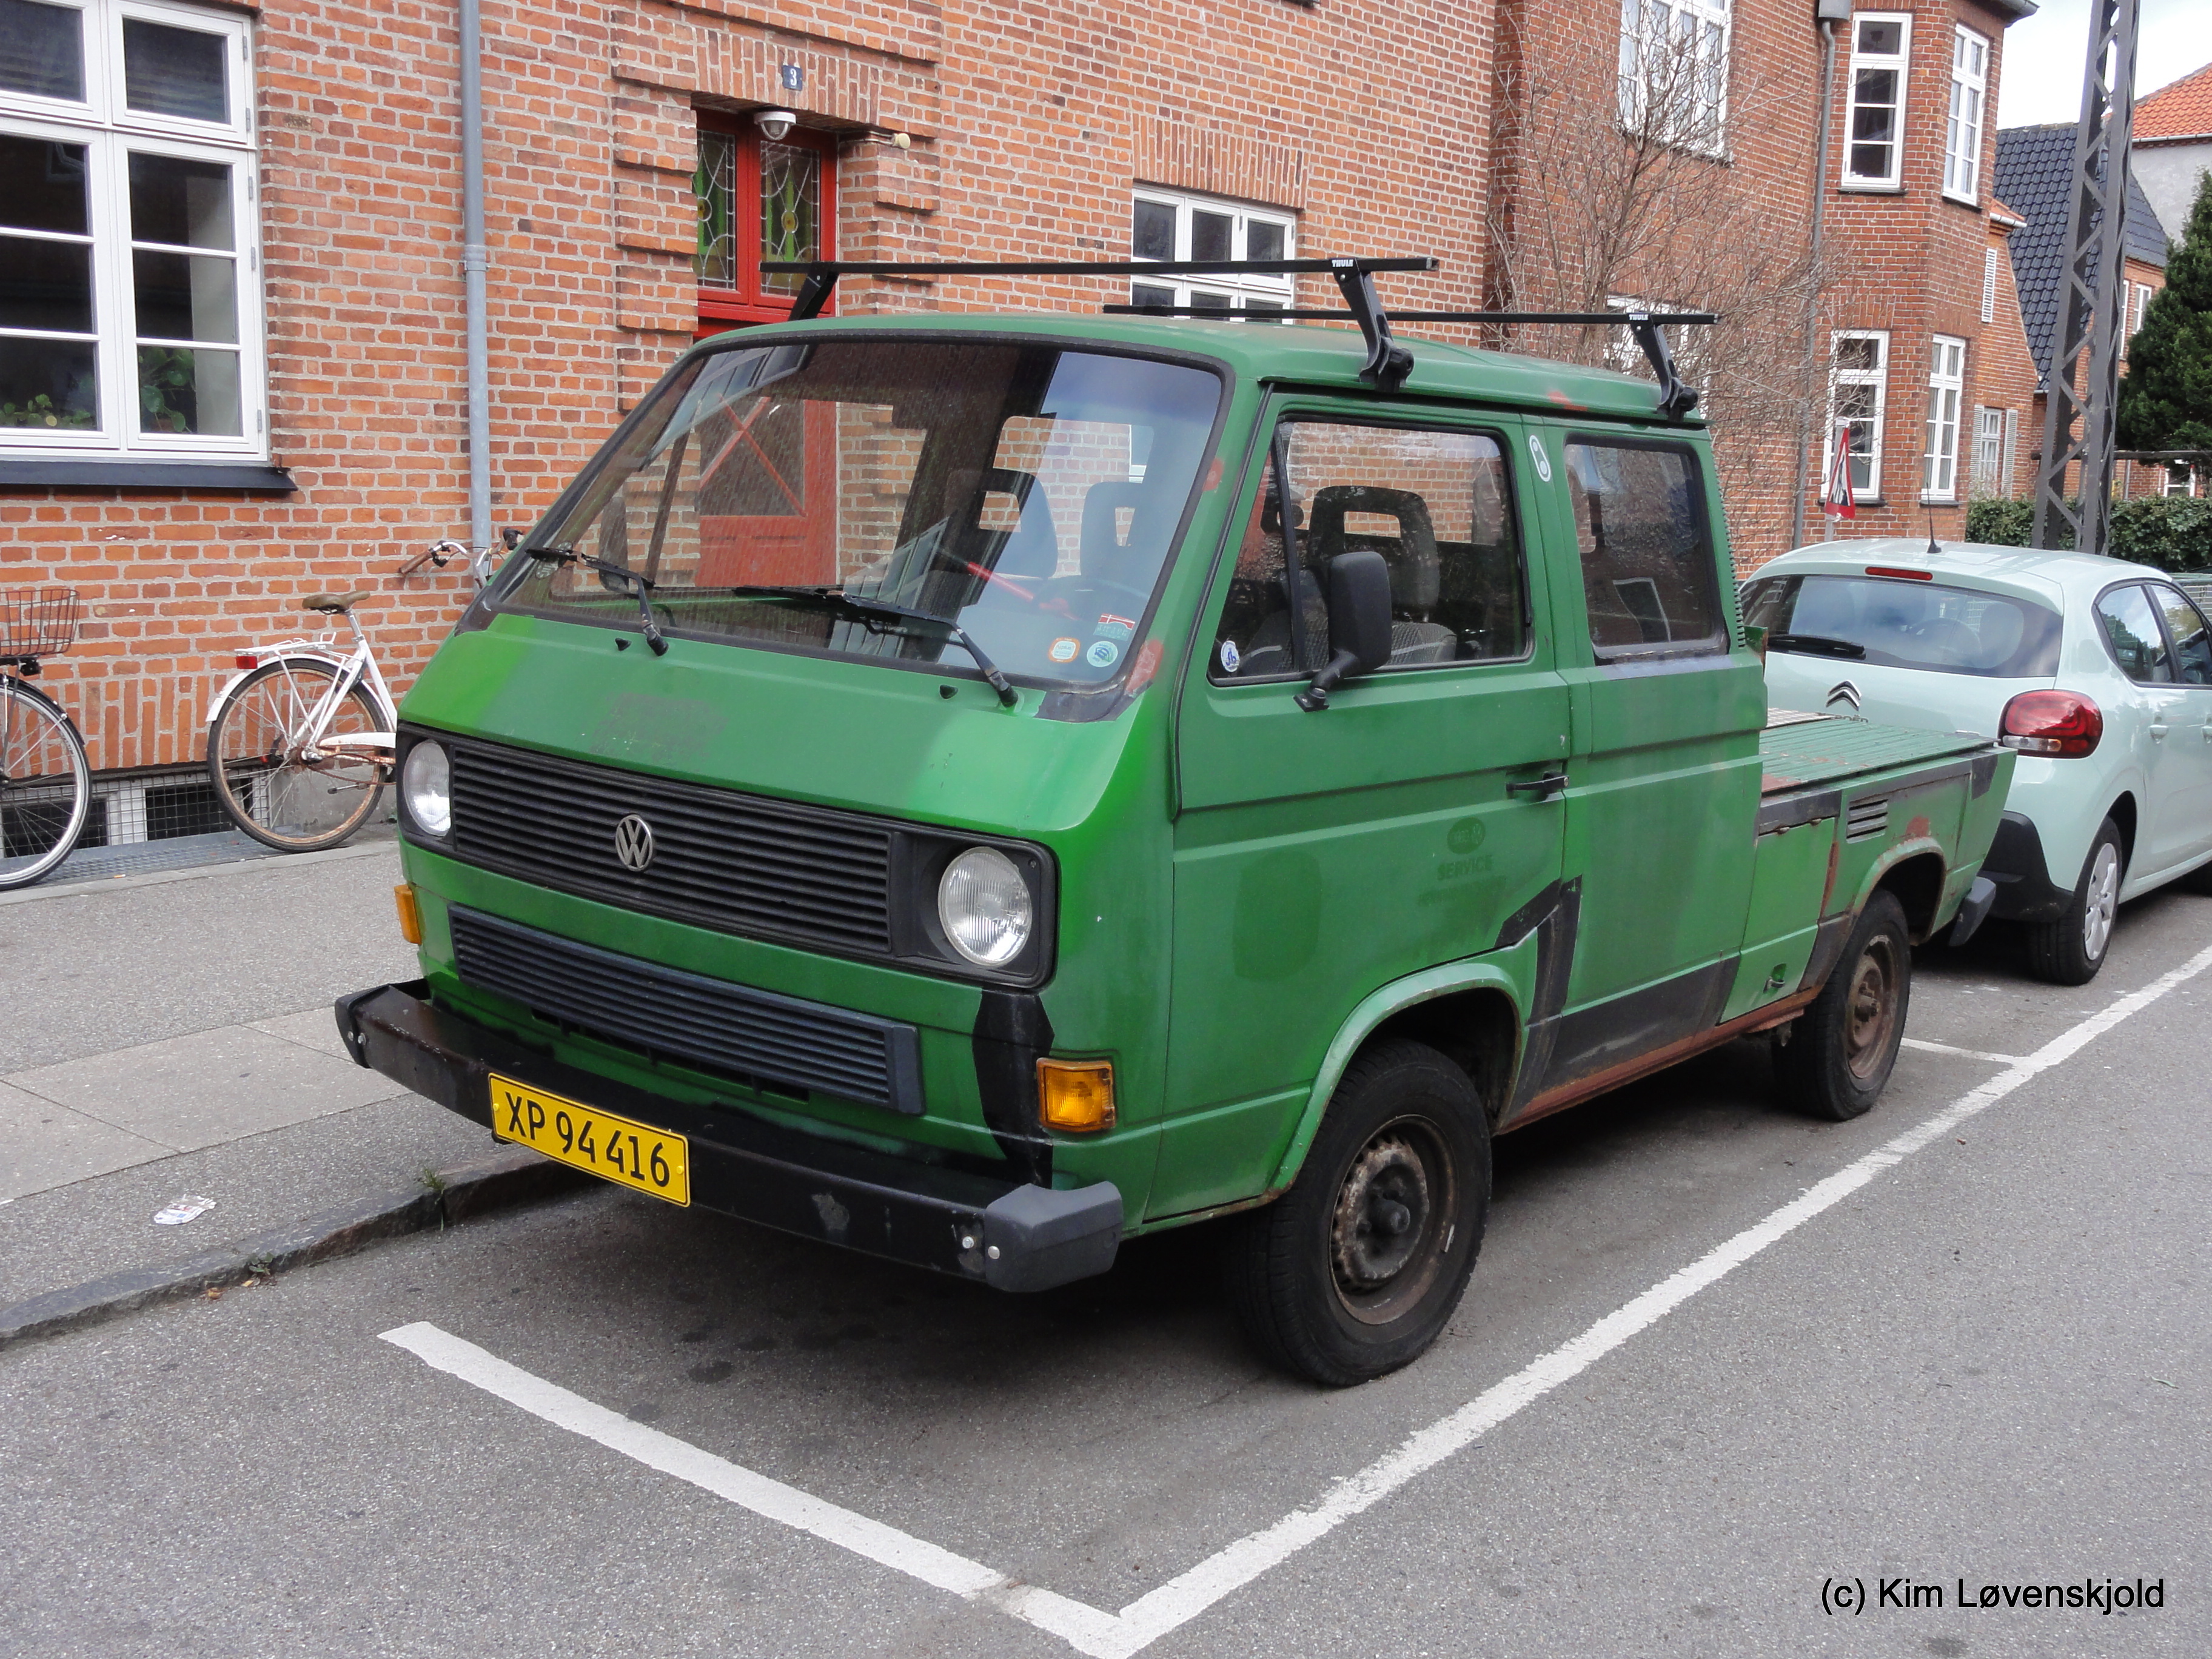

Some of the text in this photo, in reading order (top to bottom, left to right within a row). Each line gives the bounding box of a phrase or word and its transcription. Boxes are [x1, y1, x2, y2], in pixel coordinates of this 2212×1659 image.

[789, 68, 797, 86] 3
[504, 1091, 670, 1187] XP 94 416
